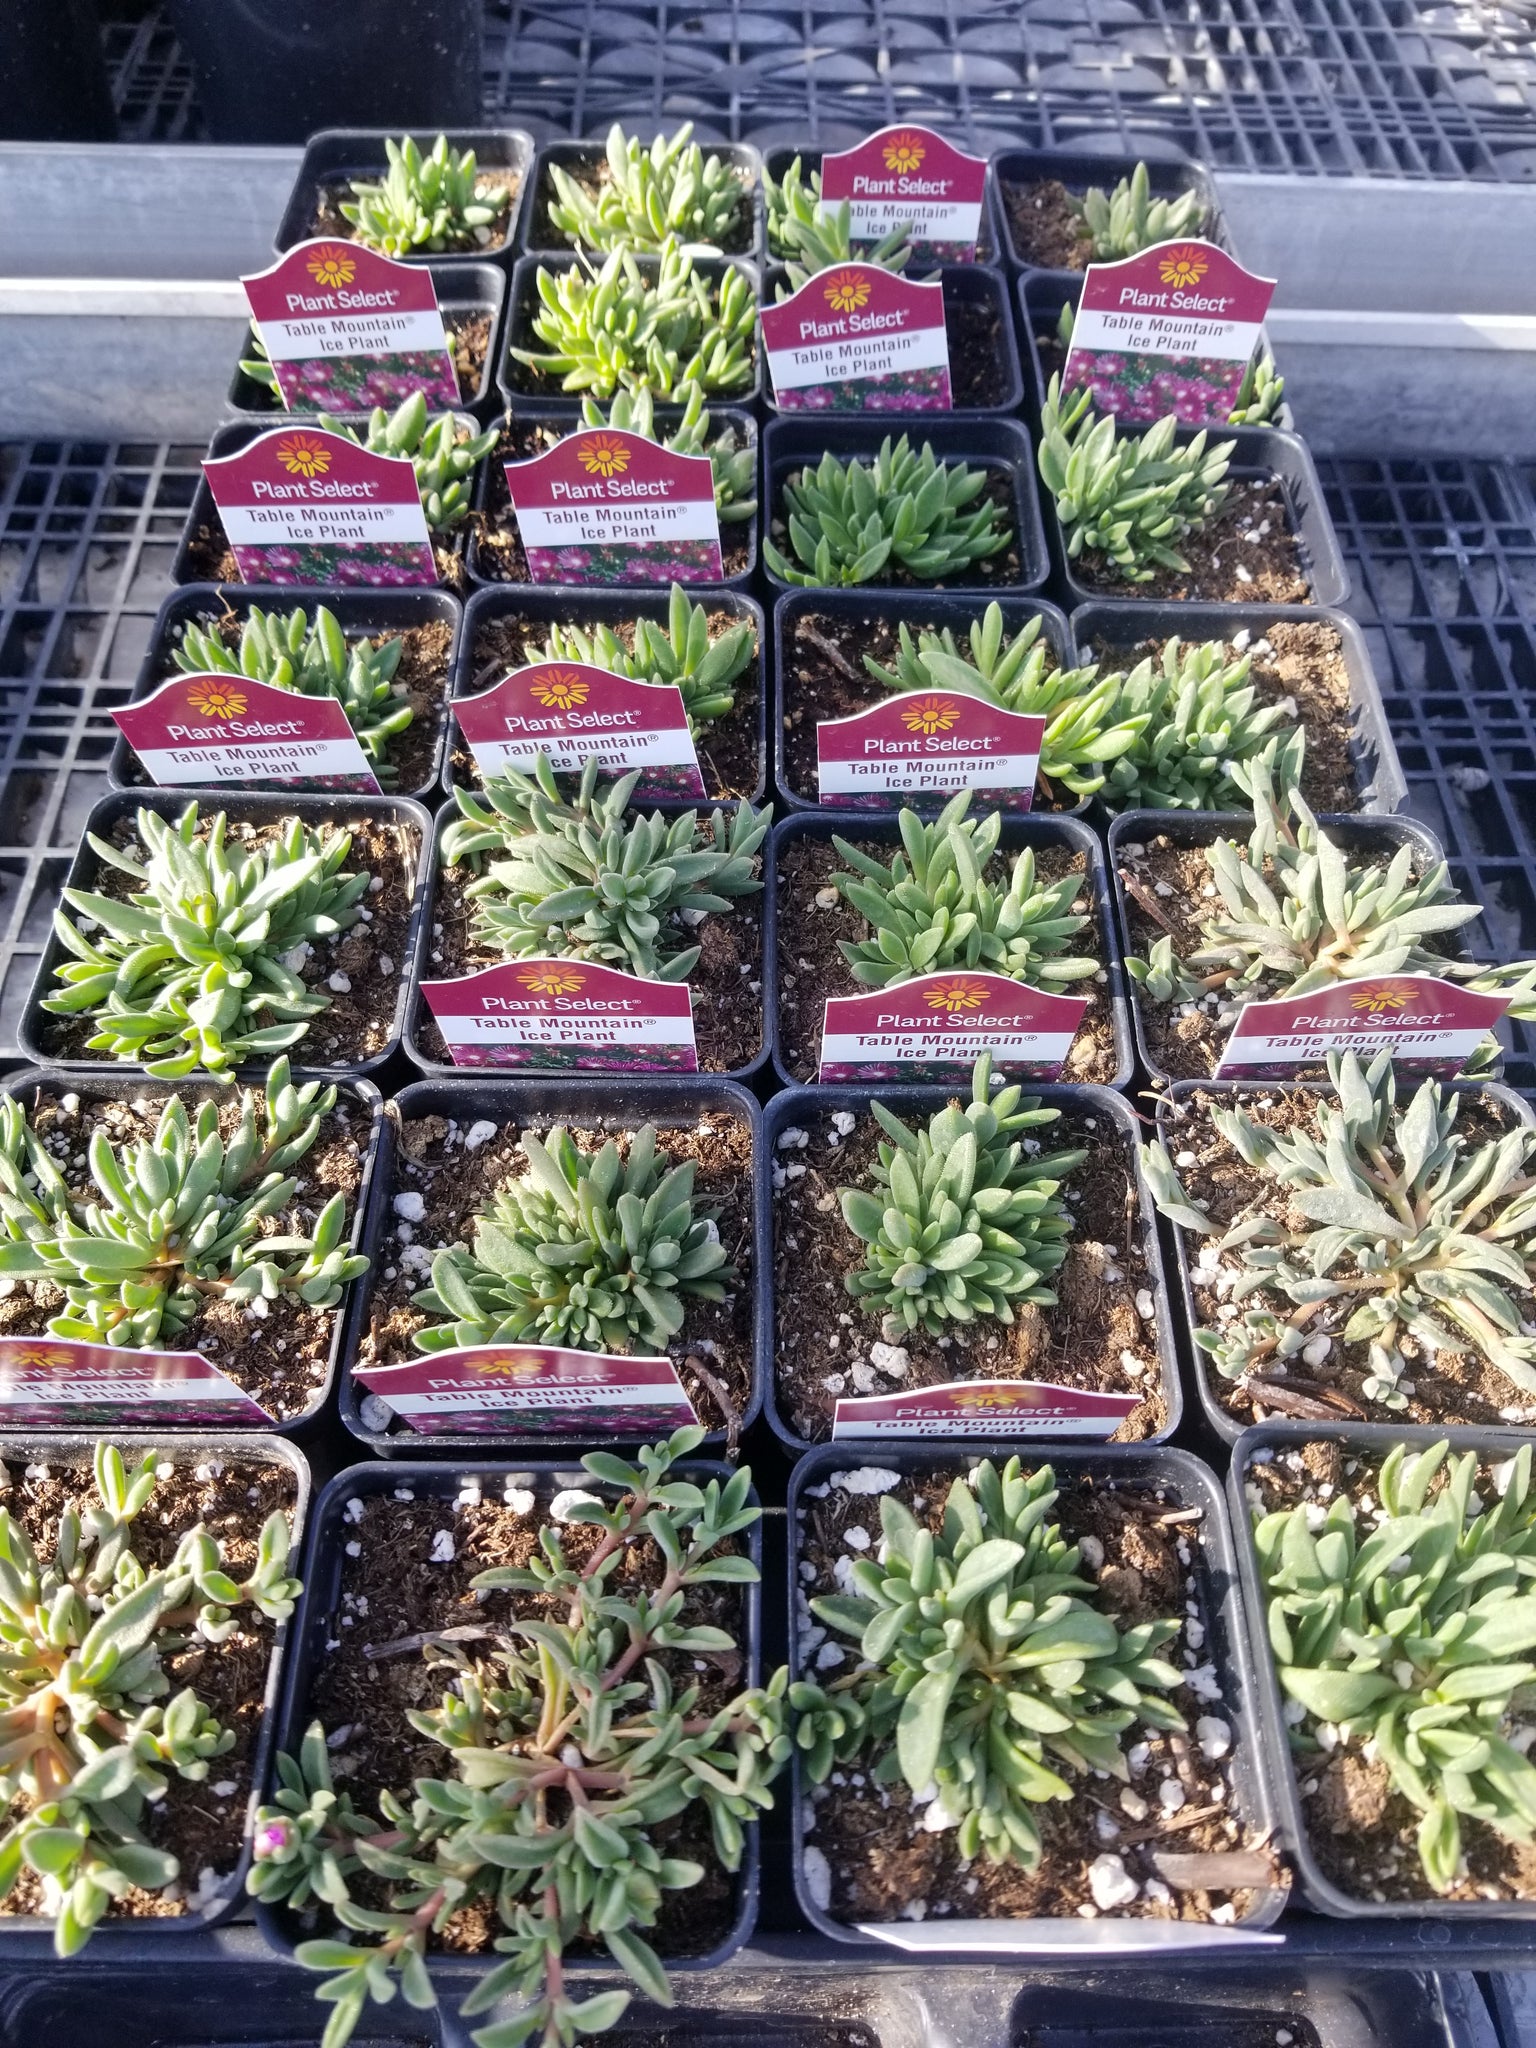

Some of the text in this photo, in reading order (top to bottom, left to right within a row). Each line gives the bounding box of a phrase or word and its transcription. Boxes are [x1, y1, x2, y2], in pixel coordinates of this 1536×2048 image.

[853, 176, 896, 195] Plant
[851, 205, 878, 217] ble
[867, 221, 927, 235] Ice Pnt
[286, 294, 337, 312] Plant
[1119, 287, 1168, 308] Plant
[282, 322, 326, 337] Table
[1102, 315, 1143, 330] Table
[800, 320, 848, 340] Plant
[320, 336, 390, 351] Ice Plant
[1128, 334, 1197, 351] Ice Plant
[792, 349, 833, 365] Table
[825, 356, 892, 377] Ice Plant
[252, 481, 309, 499] Plant
[551, 481, 605, 500] Plant
[246, 509, 295, 522] Table
[543, 510, 589, 524] Table
[287, 525, 365, 539] Ice Plant
[581, 524, 656, 539] Ice Plant
[505, 714, 566, 733] Plant
[166, 724, 231, 741] Plant
[864, 739, 921, 753] Plant
[166, 750, 221, 764] Table
[551, 752, 628, 768] ce Pant
[214, 761, 301, 776] Ice Plant
[848, 763, 898, 775] Table
[886, 775, 968, 788] Ice Plant
[481, 997, 552, 1010] Plant
[470, 1018, 531, 1028] Table
[876, 1014, 943, 1027] Plant
[1291, 1015, 1361, 1029] Plant
[520, 1031, 616, 1041] Ice Plant
[856, 1035, 913, 1046] Table
[1266, 1036, 1323, 1047] Table
[896, 1047, 982, 1058] Ice Plan
[428, 1376, 512, 1389] Plant
[82, 1391, 153, 1400] Plant
[420, 1392, 492, 1402] Table
[480, 1397, 595, 1408] Ice Plant
[896, 1408, 972, 1417] Plant
[872, 1420, 938, 1428] Table
[963, 1426, 1027, 1434] Plant
